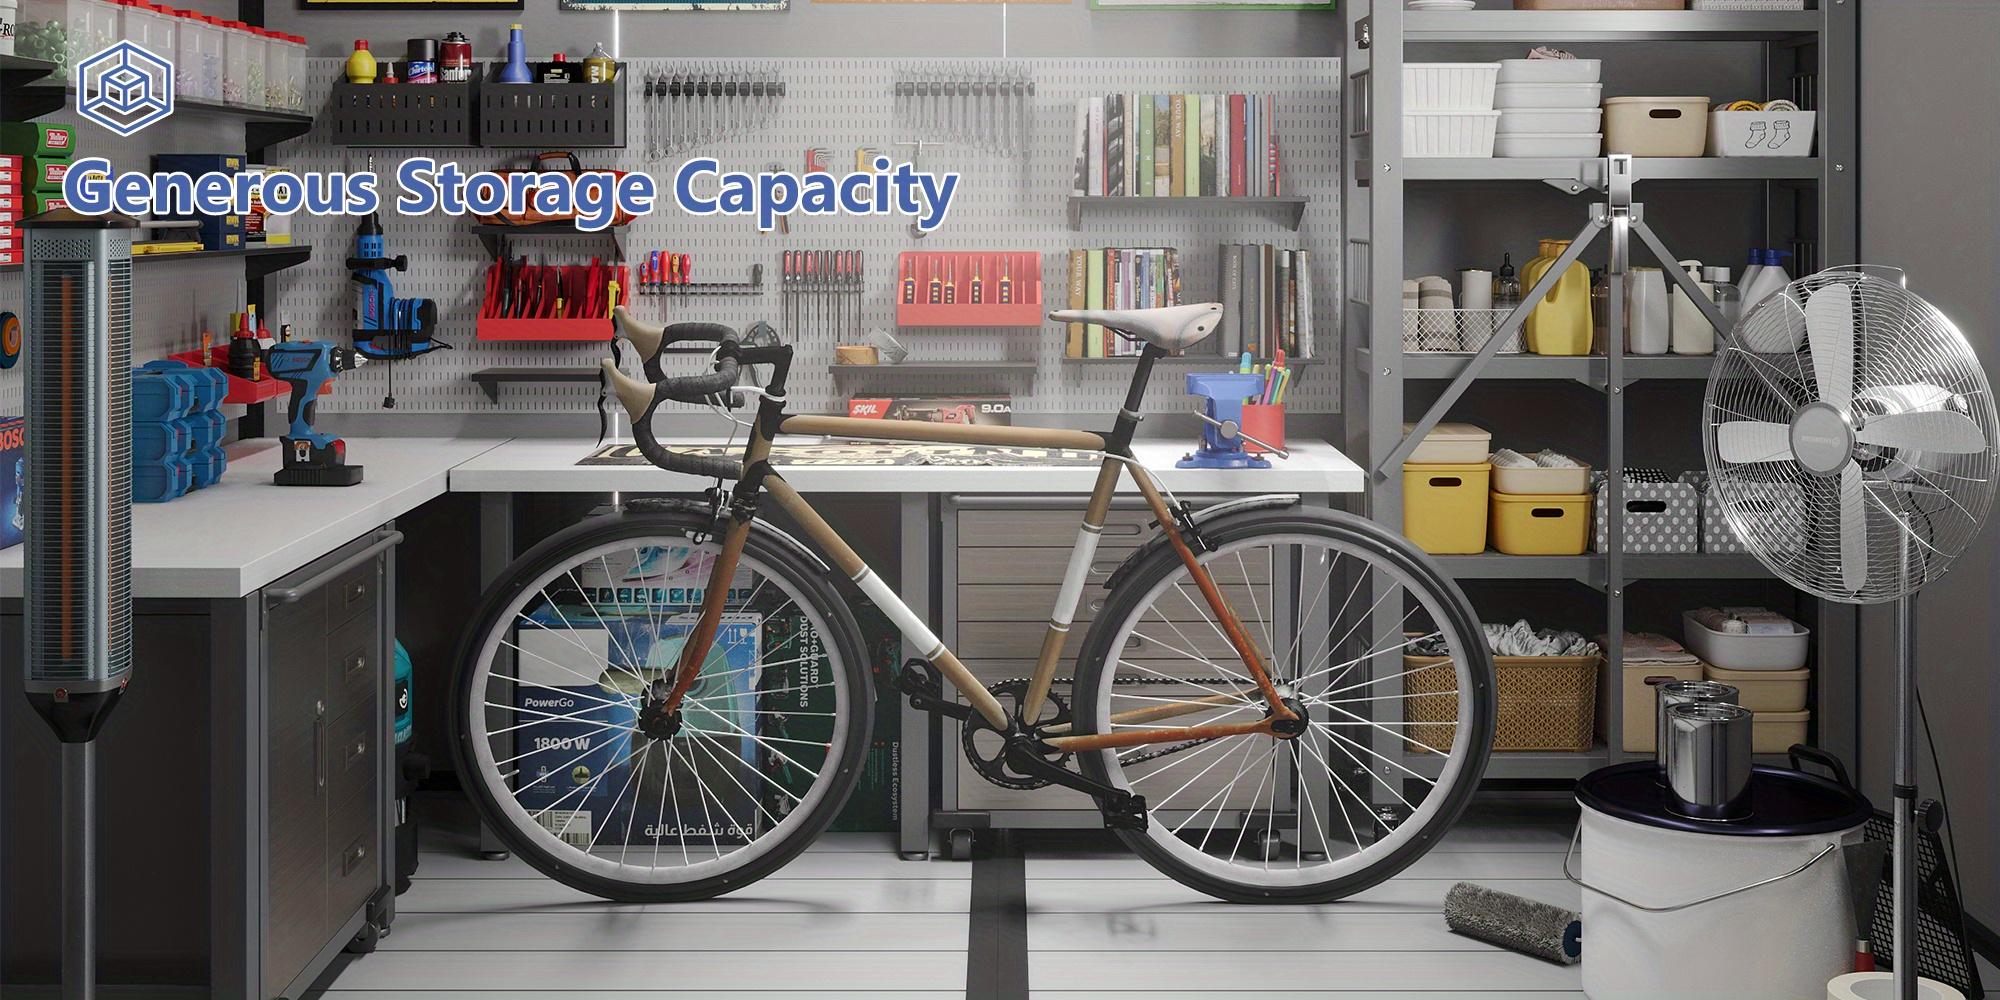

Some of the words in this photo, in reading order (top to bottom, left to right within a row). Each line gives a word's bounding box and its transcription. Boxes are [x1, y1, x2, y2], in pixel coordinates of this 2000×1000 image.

[852, 404, 878, 415] SKIL
[981, 404, 1012, 414] 9.0A
[800, 616, 809, 645] DUST
[800, 646, 809, 708] SOLUTIONS
[524, 697, 575, 708] PowerGo
[534, 737, 573, 751] 1800
[574, 738, 591, 751] W
[892, 741, 900, 777] Dustless
[890, 777, 900, 821] Ecosystem
[727, 823, 753, 839] قوة
